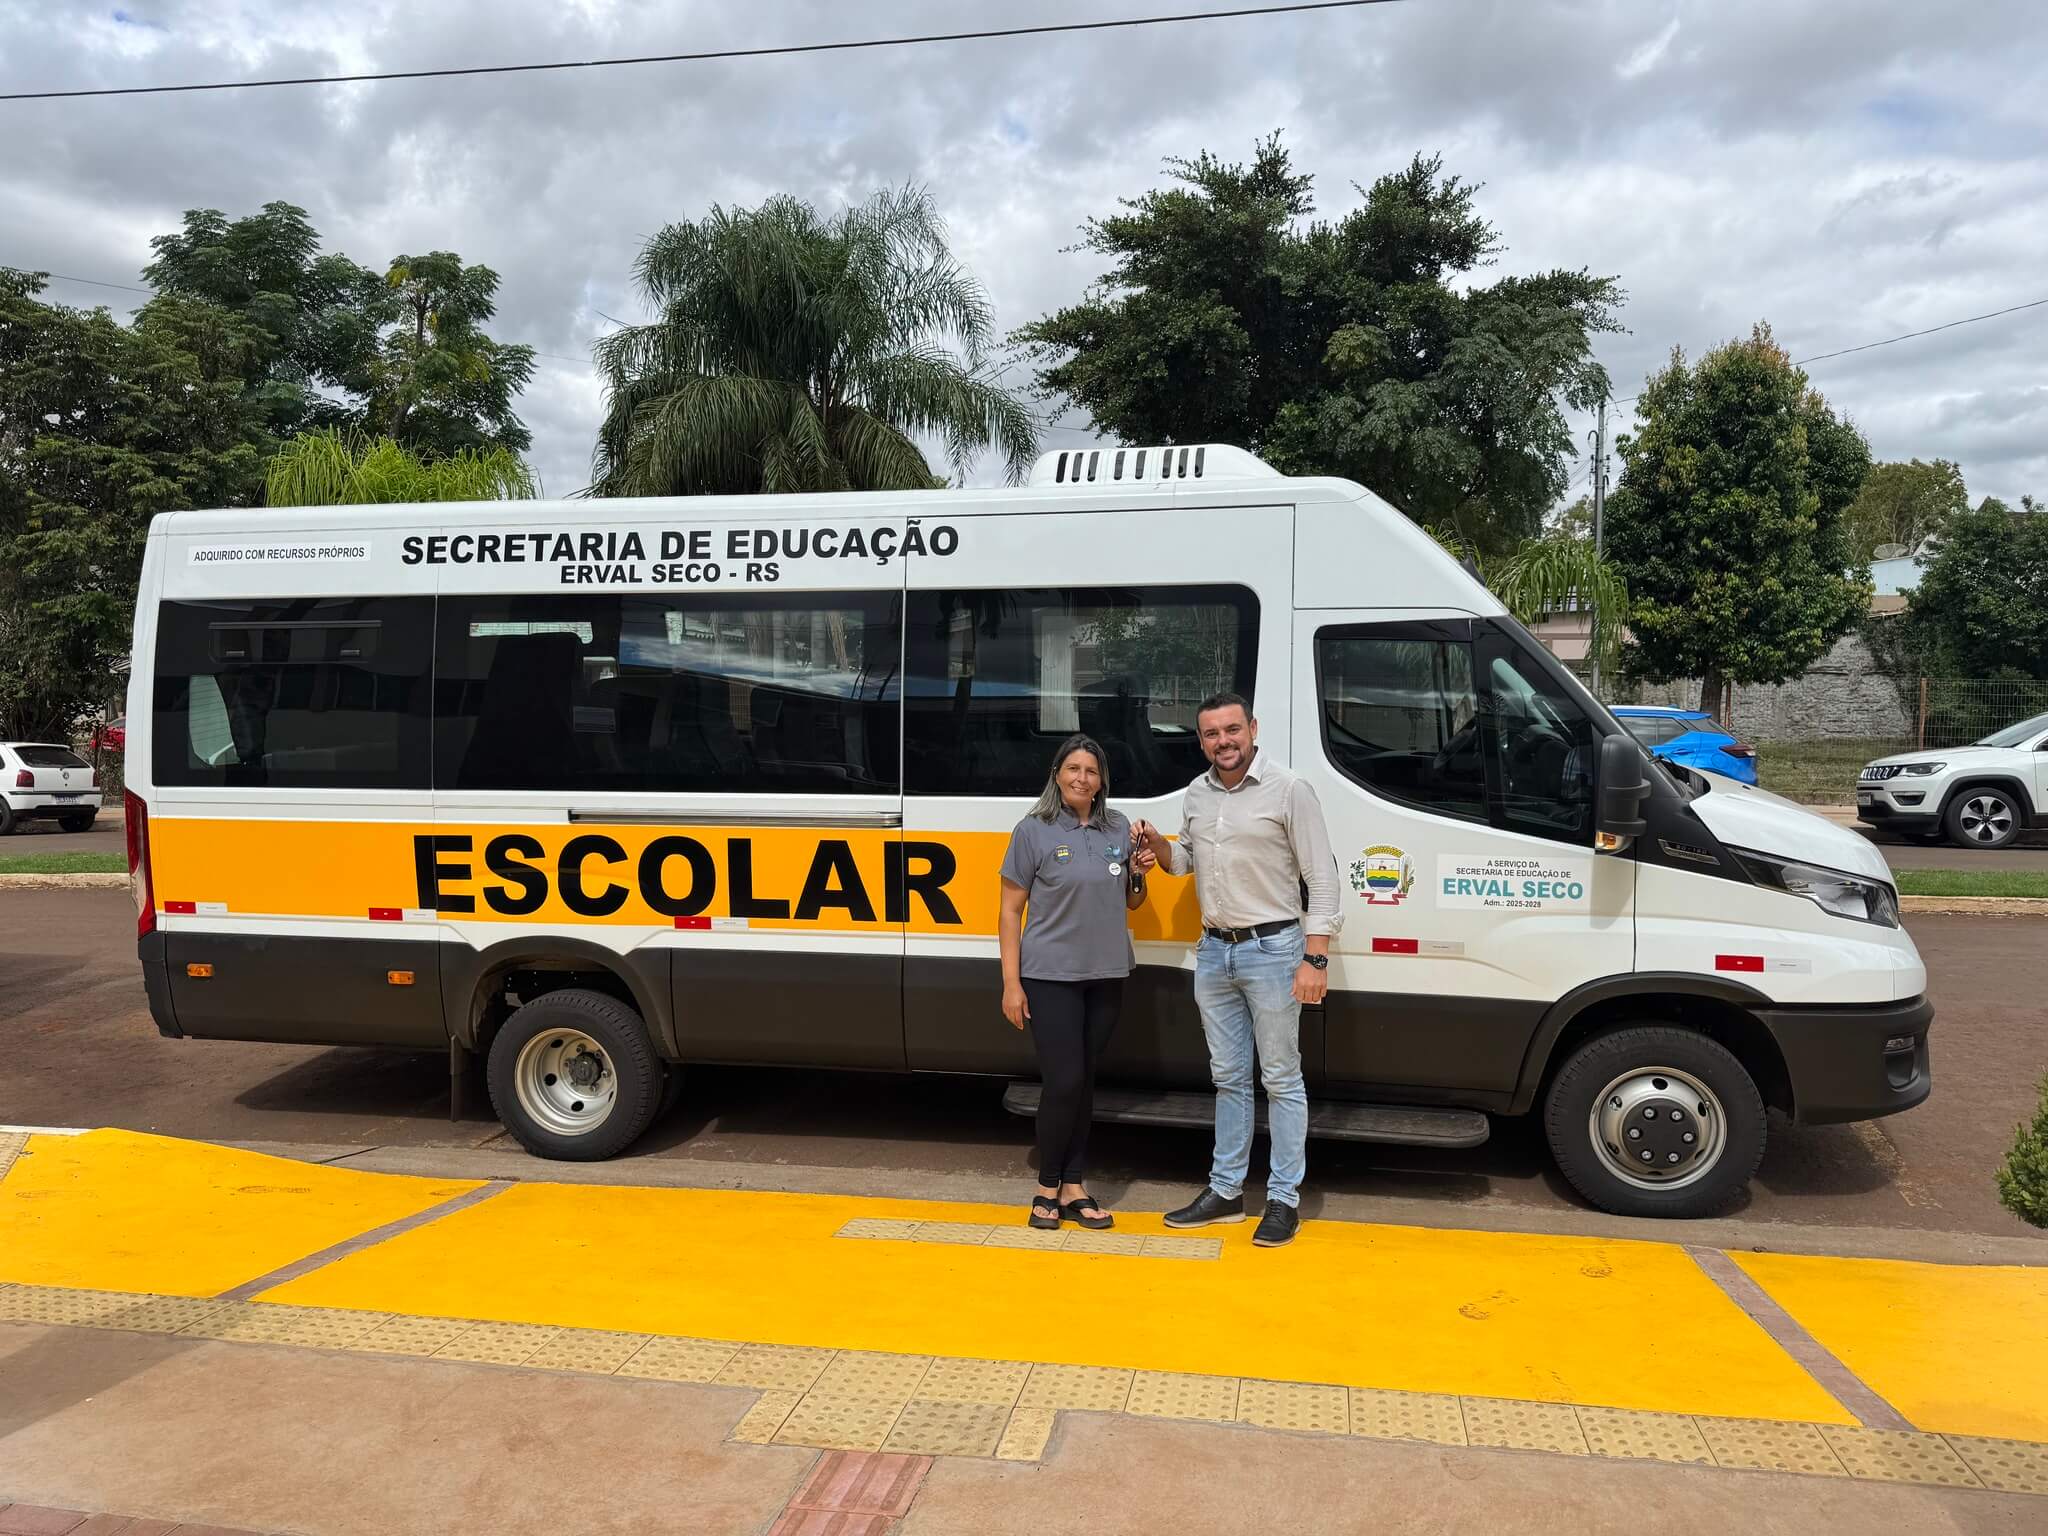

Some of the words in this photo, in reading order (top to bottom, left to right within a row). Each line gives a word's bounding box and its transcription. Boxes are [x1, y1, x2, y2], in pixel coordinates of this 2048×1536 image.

[401, 532, 646, 565] SECRETARIA
[660, 530, 712, 560] DE
[727, 519, 959, 565] EDUCAÇÃO
[194, 550, 243, 561] ADQUIRIDO
[245, 549, 265, 560] COM
[267, 547, 316, 559] RECURSOS
[318, 545, 365, 558] PRÓPRIOS
[560, 564, 642, 584] ERVAL
[651, 563, 721, 583] SECO
[746, 562, 780, 582] RS
[1456, 867, 1503, 876] SECRETARIA
[1516, 869, 1559, 878] EDUCAÇÃO
[1494, 860, 1527, 869] SERVIÇO
[413, 834, 963, 925] ESCOLAR
[1443, 878, 1515, 897] ERVAL
[1522, 880, 1583, 899] SECO
